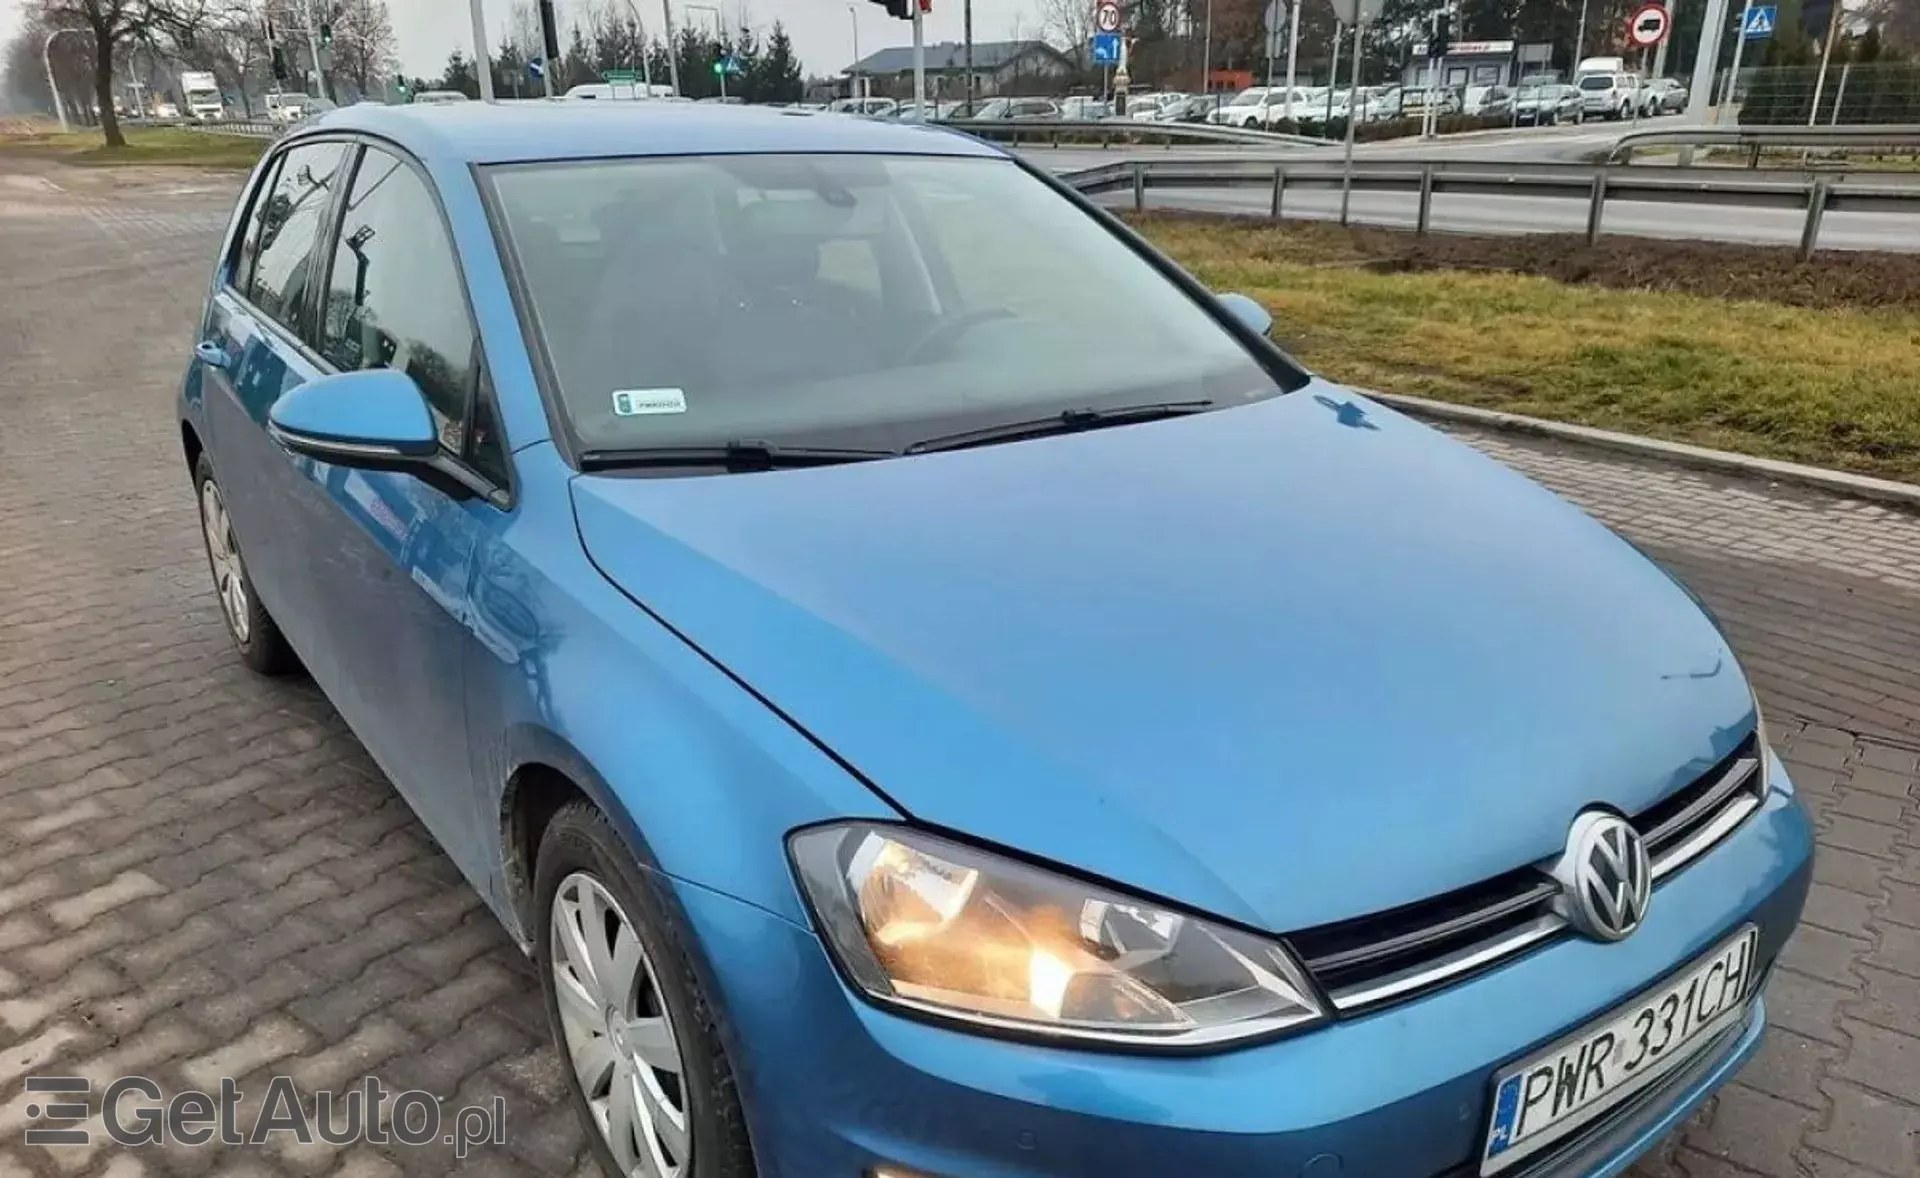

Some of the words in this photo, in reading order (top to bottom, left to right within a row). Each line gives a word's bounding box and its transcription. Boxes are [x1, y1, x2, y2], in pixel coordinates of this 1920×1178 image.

[1102, 9, 1117, 26] 70
[1516, 1032, 1615, 1136] PWR
[1624, 941, 1747, 1071] 331CH
